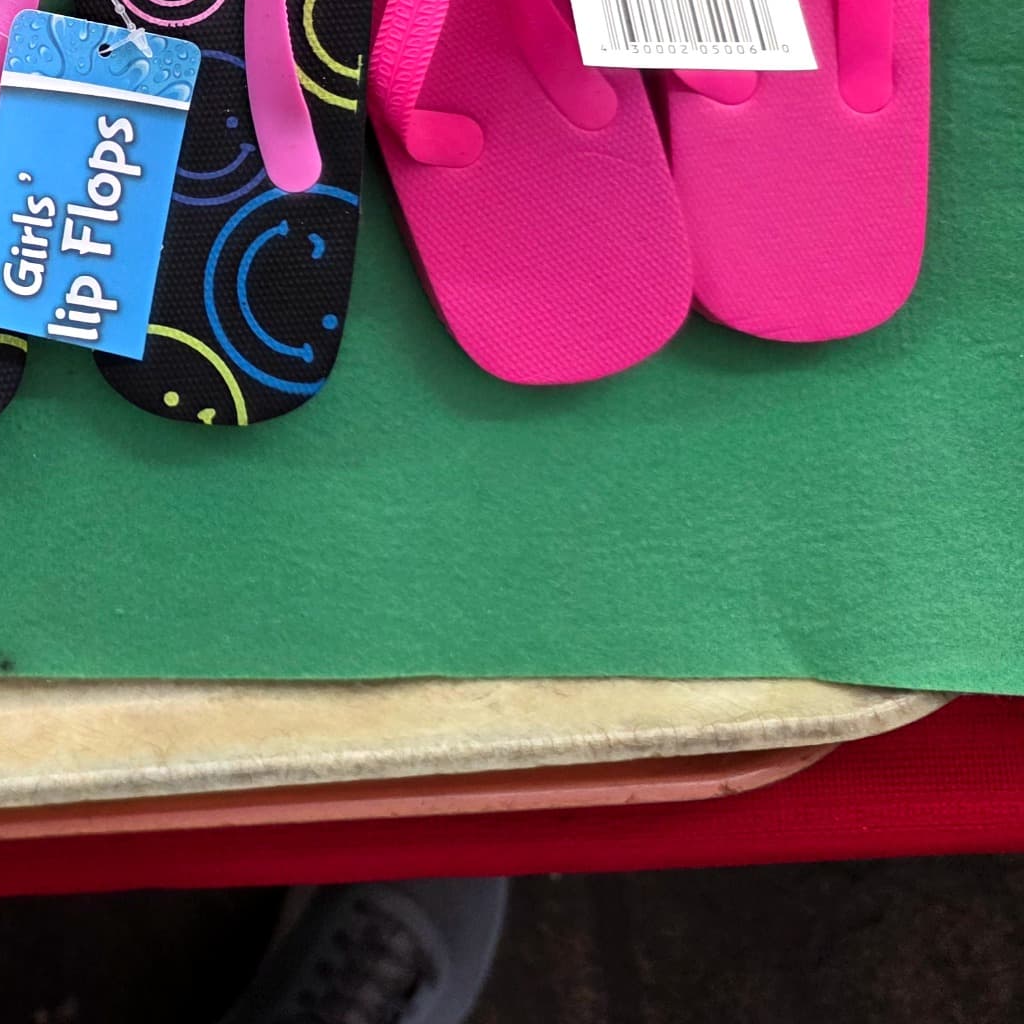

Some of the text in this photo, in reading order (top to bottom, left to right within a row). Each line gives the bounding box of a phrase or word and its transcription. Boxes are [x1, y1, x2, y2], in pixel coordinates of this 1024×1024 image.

[3, 172, 56, 296] Girls'
[47, 115, 141, 340] lip Flops
